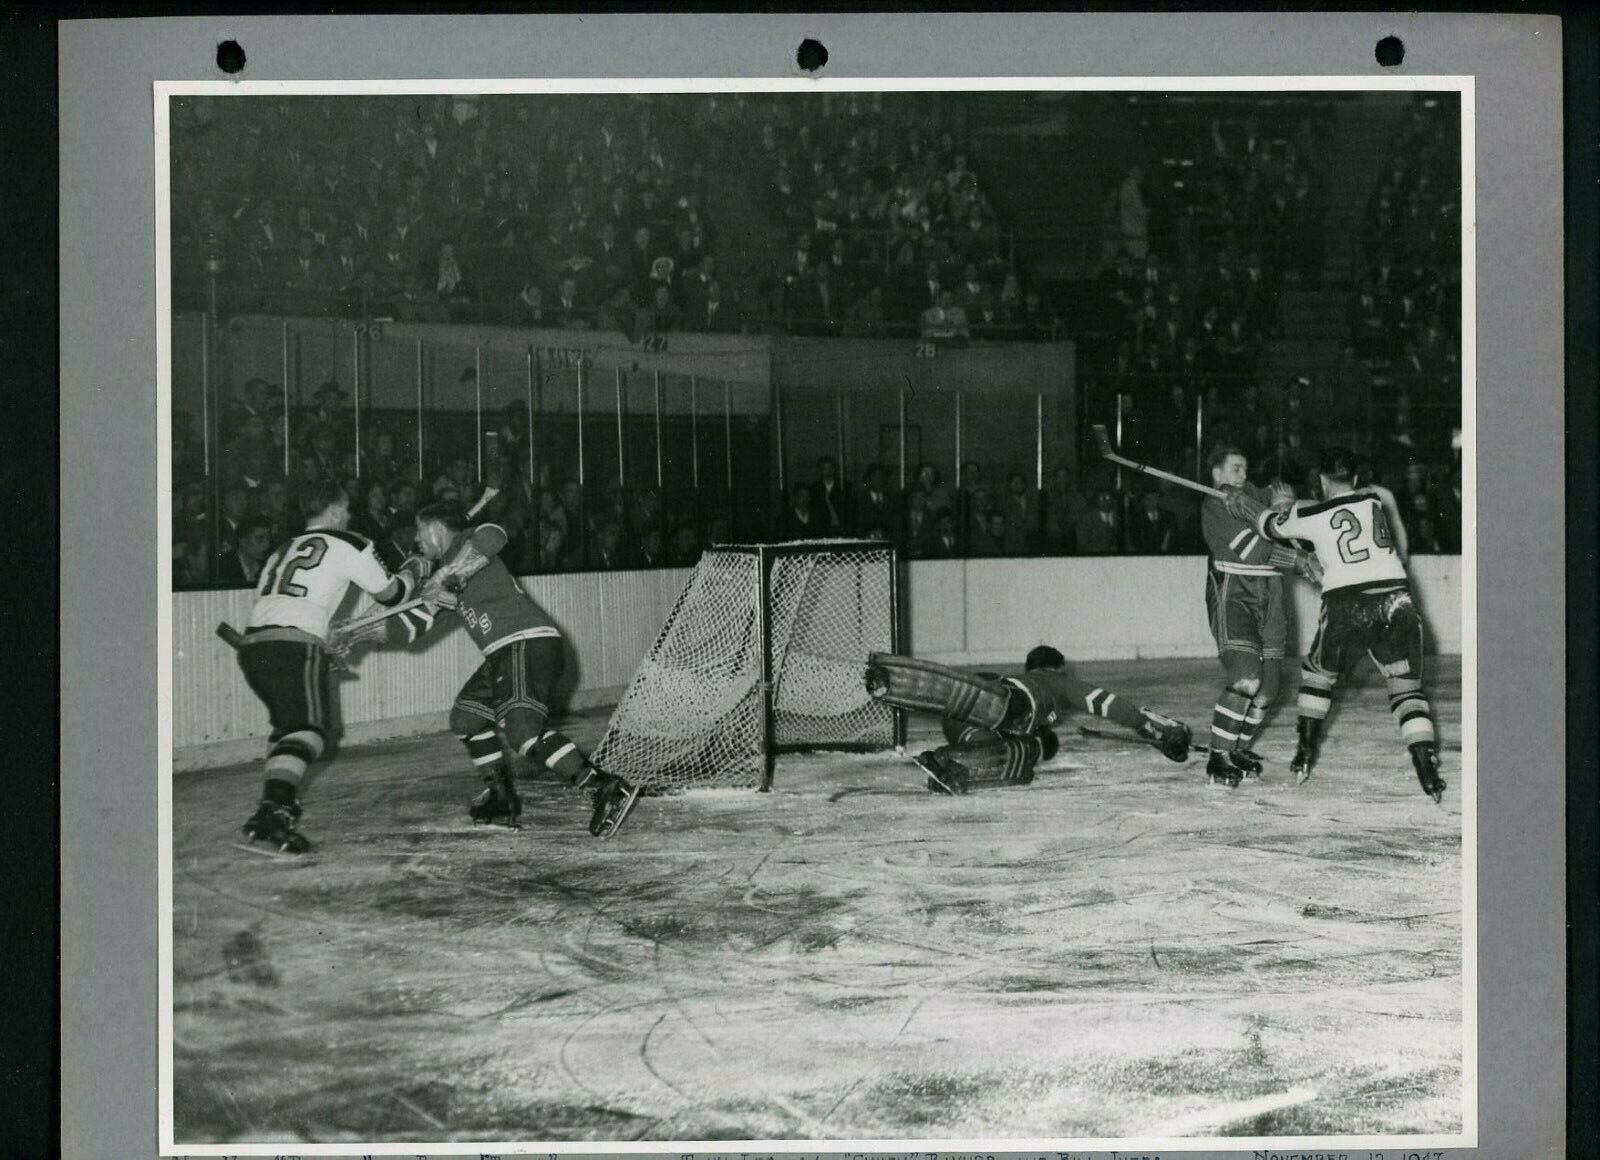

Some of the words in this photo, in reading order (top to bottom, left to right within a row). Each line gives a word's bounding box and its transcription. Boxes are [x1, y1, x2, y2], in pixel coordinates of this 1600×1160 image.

[357, 322, 381, 341] 26
[1330, 508, 1393, 563] 24
[261, 536, 328, 597] 12
